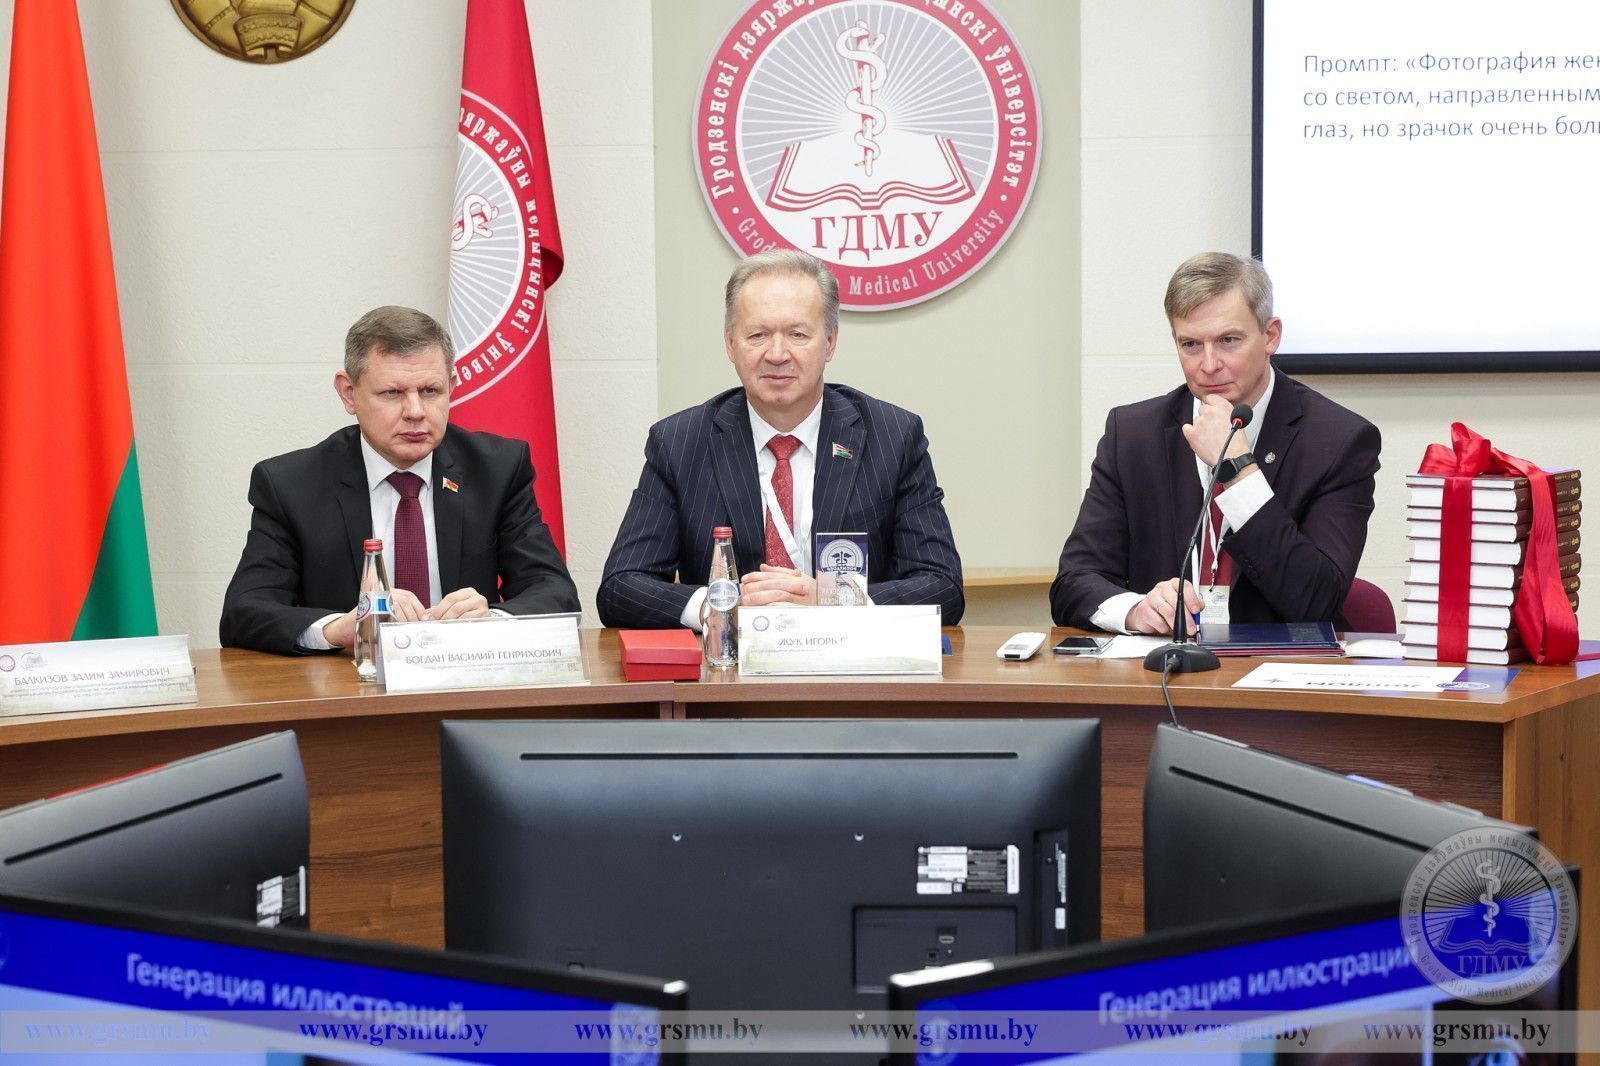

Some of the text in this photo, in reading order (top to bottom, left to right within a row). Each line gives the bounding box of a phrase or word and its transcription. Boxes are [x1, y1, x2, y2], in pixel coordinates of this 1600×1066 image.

[1304, 54, 1397, 77] Промпт:
[1406, 51, 1556, 75] «Фотография
[985, 45, 1033, 188] ўніверсітэт
[1303, 91, 1327, 106] со
[1335, 90, 1420, 107] светом,
[707, 60, 739, 199] Гродзенскі
[1303, 115, 1600, 140] глаз, но зрачок очень бол
[811, 211, 943, 261] ГДМУ
[848, 274, 919, 297] Medical
[922, 208, 1005, 281] University
[511, 199, 542, 334] медыцынскі
[406, 648, 562, 665] БОГДАН ВАСИЛИЙ ГЕНРИХОВИЧ
[778, 637, 802, 647] ЖУК
[805, 637, 837, 646] ИГОРЬ
[14, 667, 170, 686] БАЛКИЗОВ ЗАЛИМ ЗАМИРОВИЧ
[126, 952, 266, 1007] Генерация
[1098, 975, 1242, 1025] Генерация
